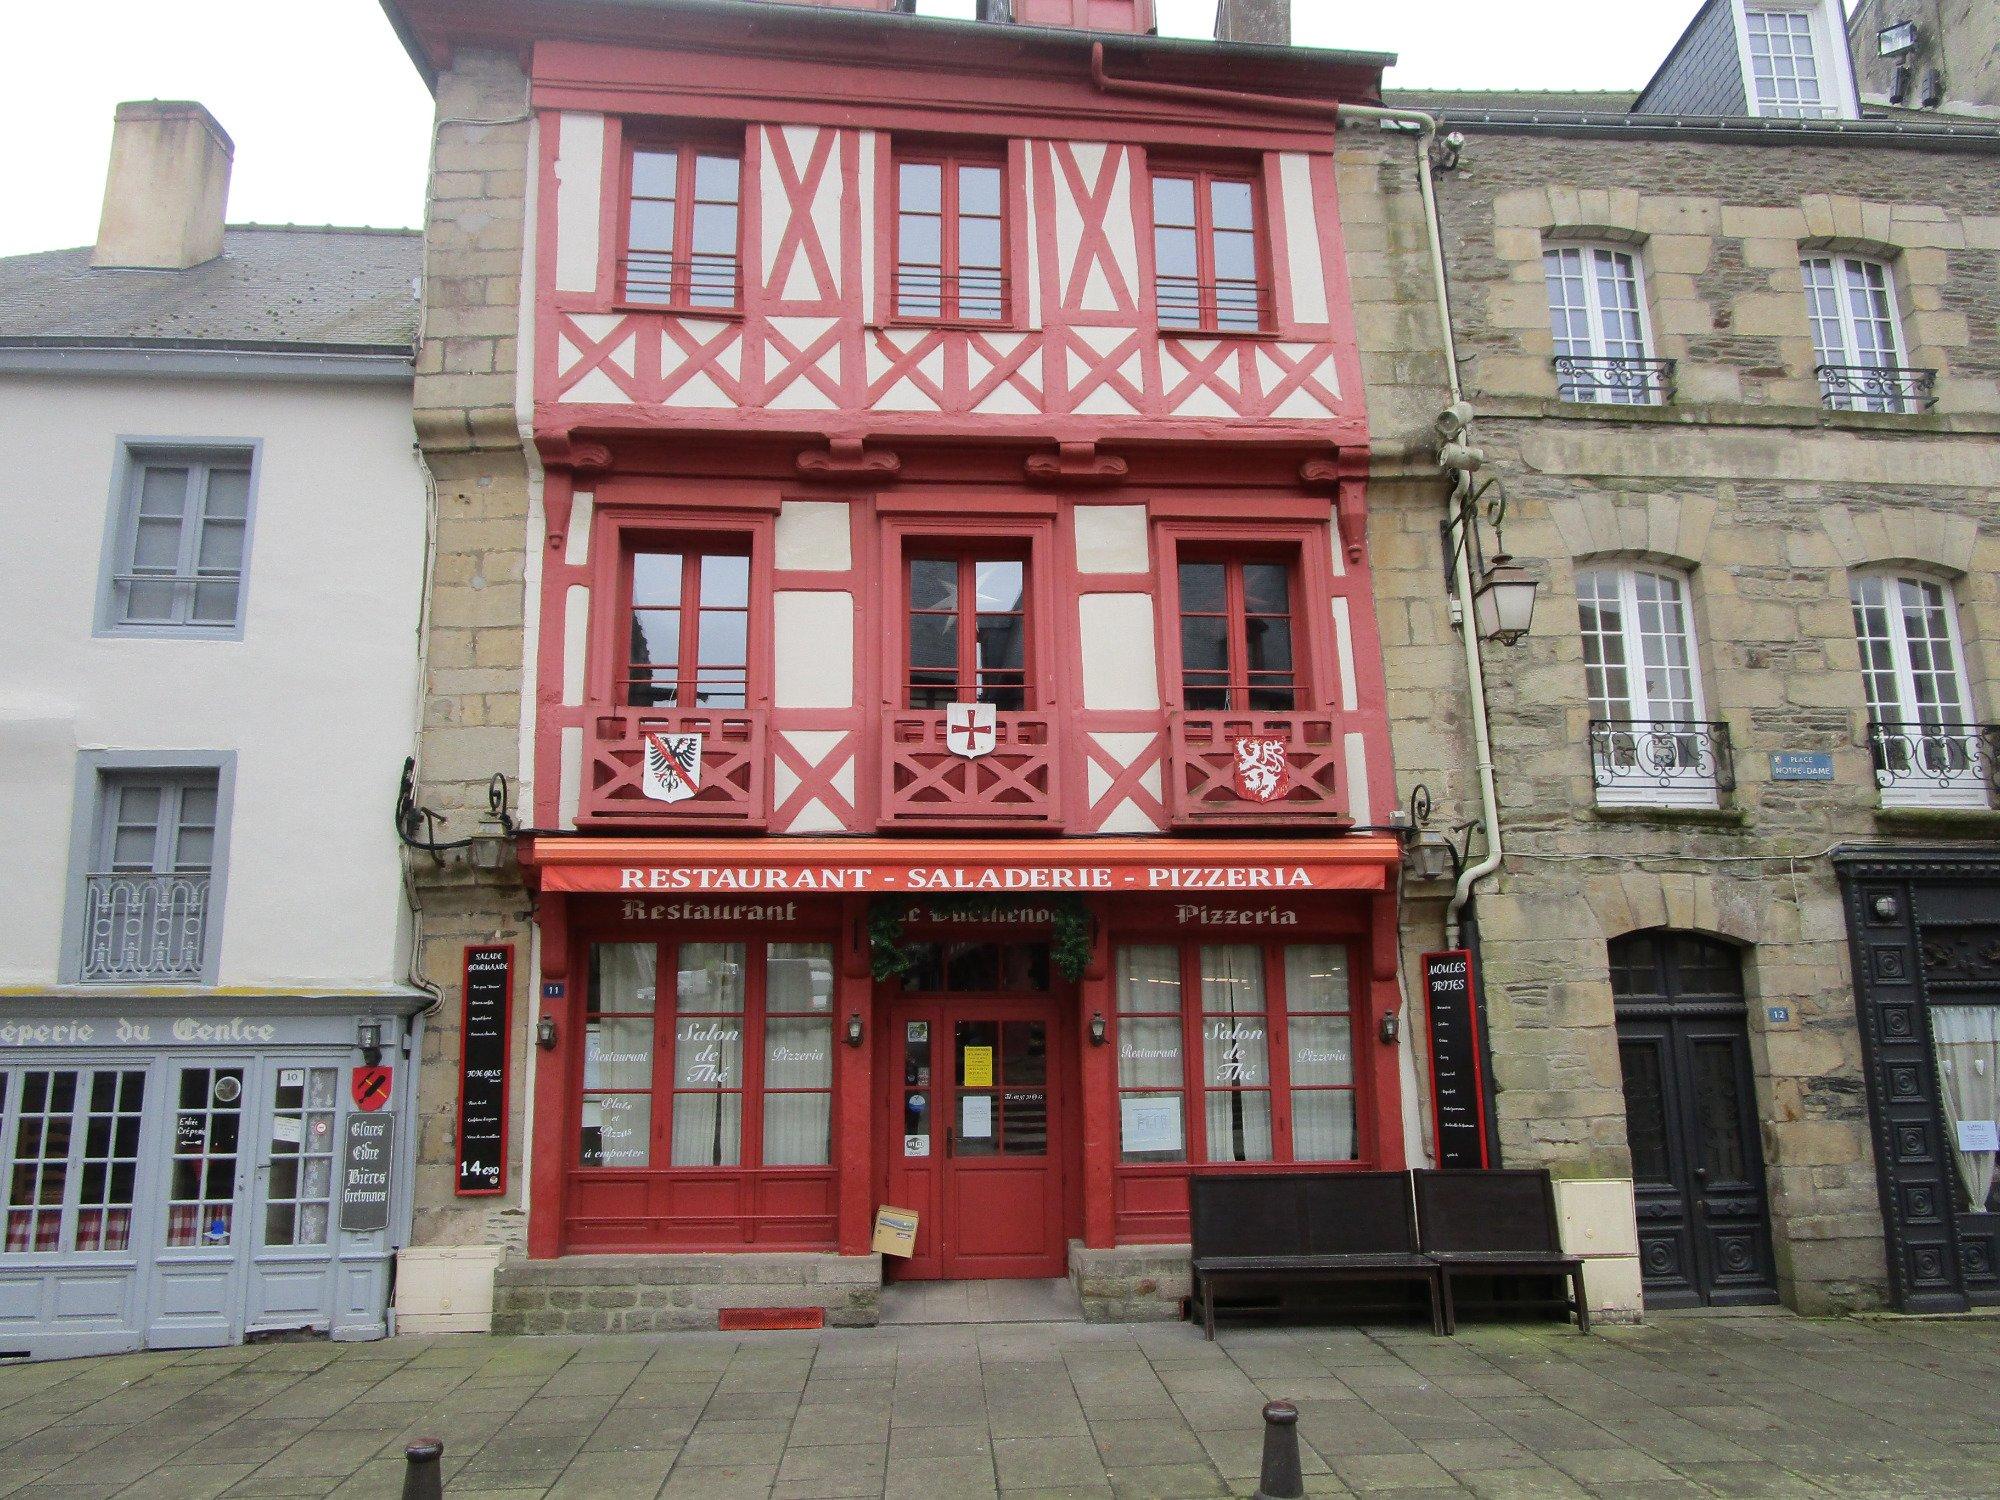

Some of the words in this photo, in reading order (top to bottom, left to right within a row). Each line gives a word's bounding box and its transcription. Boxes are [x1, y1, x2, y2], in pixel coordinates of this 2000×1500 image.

[1776, 767, 1831, 775] NOTRE-DAME
[620, 868, 871, 888] RESTAURANT
[907, 868, 1112, 888] SALADERIE
[1147, 867, 1313, 887] PIZZERIA
[621, 899, 798, 922] Restaurant
[1174, 903, 1298, 925] Pizzeria
[475, 952, 502, 960] SALADE
[1428, 962, 1466, 975] MOULES
[549, 986, 559, 995] 11
[1432, 979, 1465, 991] FRITES
[1774, 1010, 1785, 1019] 12
[116, 1017, 150, 1042] du
[173, 1017, 276, 1042] Centre
[677, 1022, 740, 1041] Salon
[1204, 1022, 1264, 1040] Salon
[588, 1047, 648, 1062] Restaurant
[695, 1044, 719, 1062] de
[771, 1046, 825, 1062] Pizzeria
[1121, 1044, 1179, 1060] Restaurant
[1223, 1042, 1246, 1060] de
[1296, 1048, 1347, 1063] Pizzeria
[286, 1073, 298, 1081] 10
[686, 1064, 729, 1083] Thé
[1216, 1062, 1256, 1081] Thé
[601, 1097, 632, 1110] Plats
[351, 1121, 386, 1136] Glaces
[597, 1125, 632, 1138] Pizzas
[353, 1142, 379, 1160] Cidre
[595, 1149, 644, 1161] emporter
[348, 1167, 387, 1186] Bières
[344, 1189, 387, 1203] bretonnes
